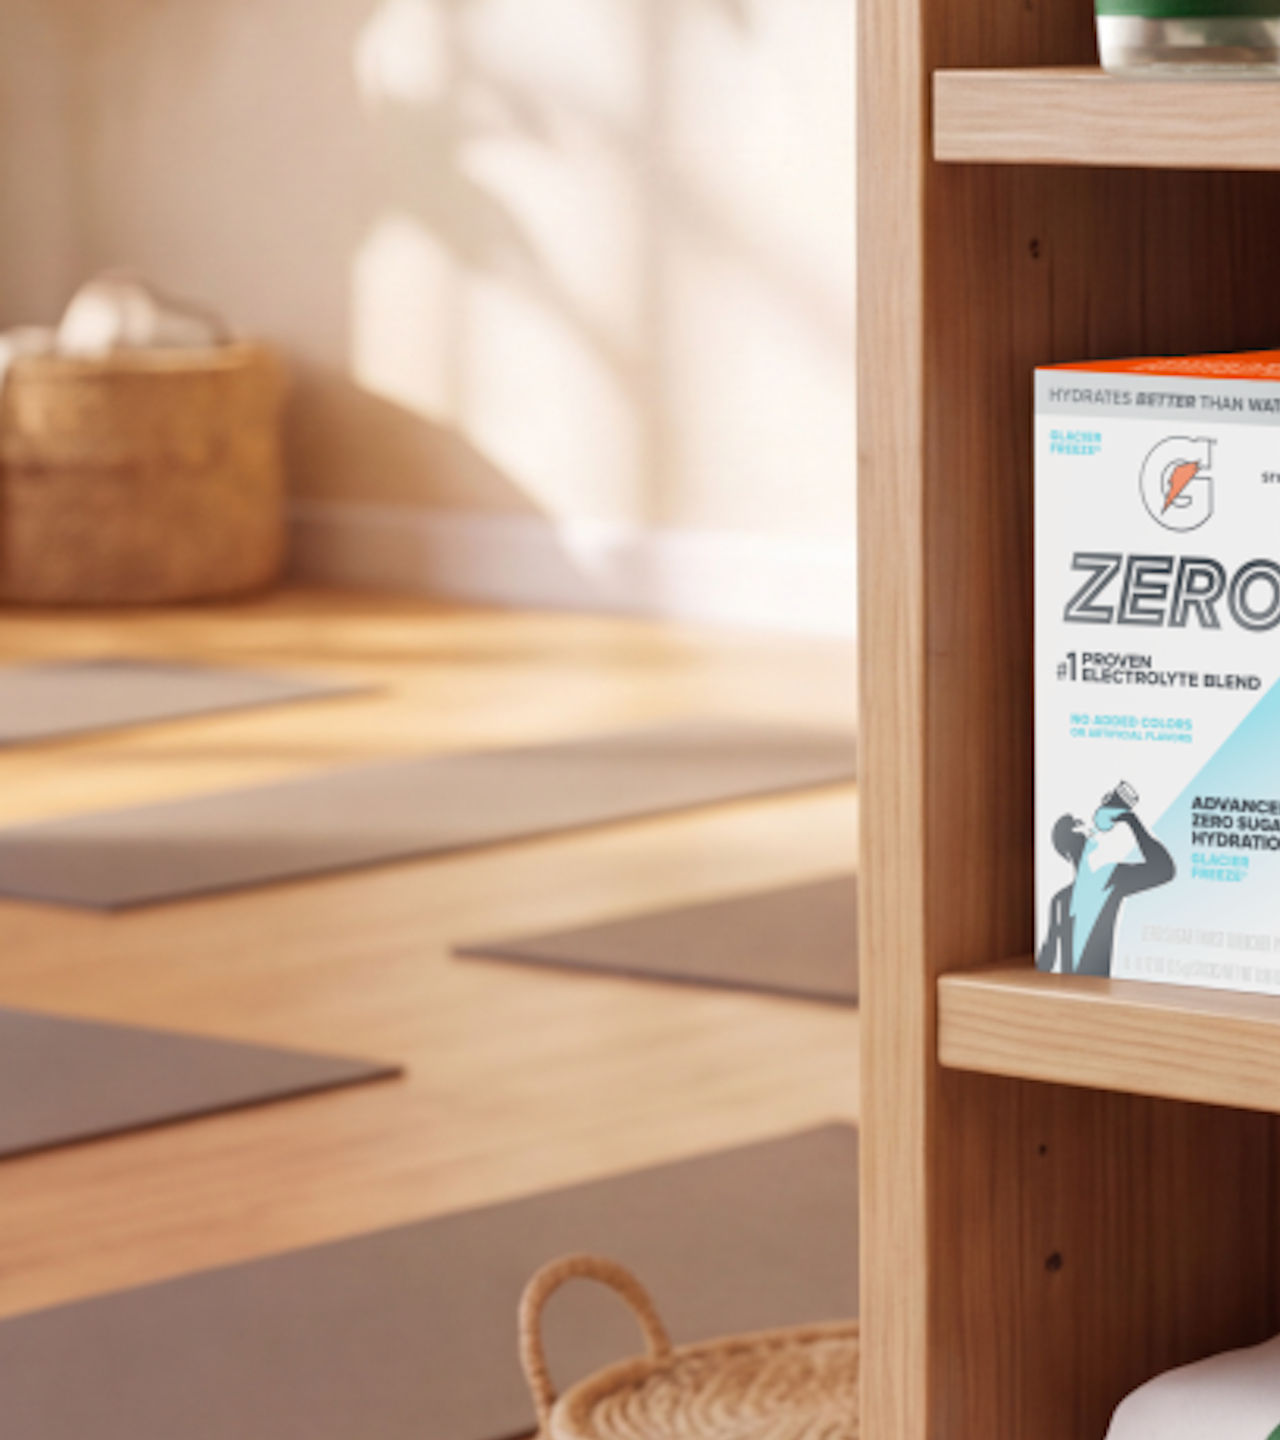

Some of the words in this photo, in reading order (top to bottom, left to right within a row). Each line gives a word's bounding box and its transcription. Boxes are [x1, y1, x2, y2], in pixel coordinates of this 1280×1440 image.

[1049, 387, 1132, 406] HYDRATES
[1136, 392, 1196, 409] BETTER
[1201, 395, 1243, 411] THAN
[1082, 652, 1152, 669] PROVEN
[1082, 668, 1199, 688] ELECTROLYTE
[1204, 674, 1262, 690] BLEND
[1192, 813, 1232, 830] ZERO
